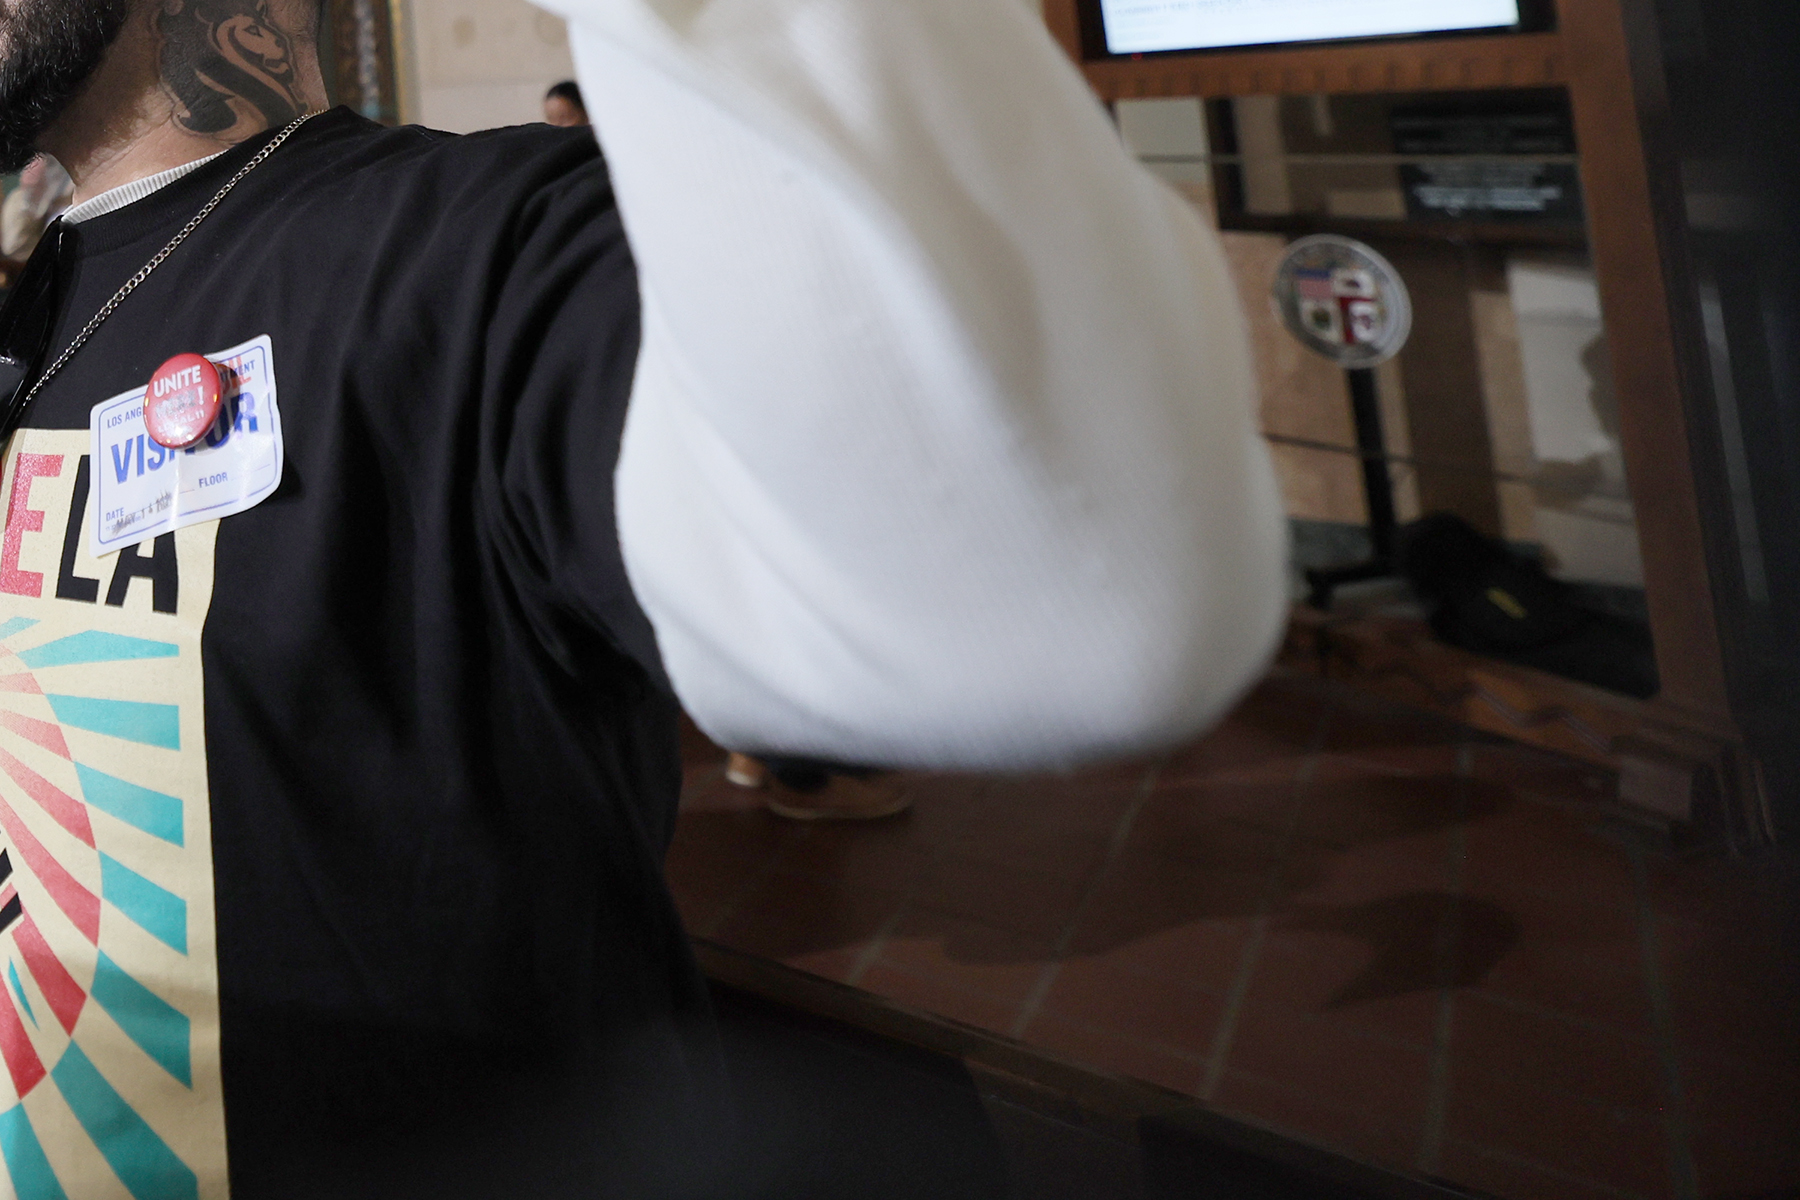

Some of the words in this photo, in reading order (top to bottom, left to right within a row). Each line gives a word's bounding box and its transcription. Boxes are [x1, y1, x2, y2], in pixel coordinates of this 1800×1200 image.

[153, 364, 202, 398] UNITE
[107, 414, 123, 429] LOS
[110, 391, 260, 486] VISOR
[198, 471, 228, 489] FLOOR
[106, 506, 125, 522] DATE
